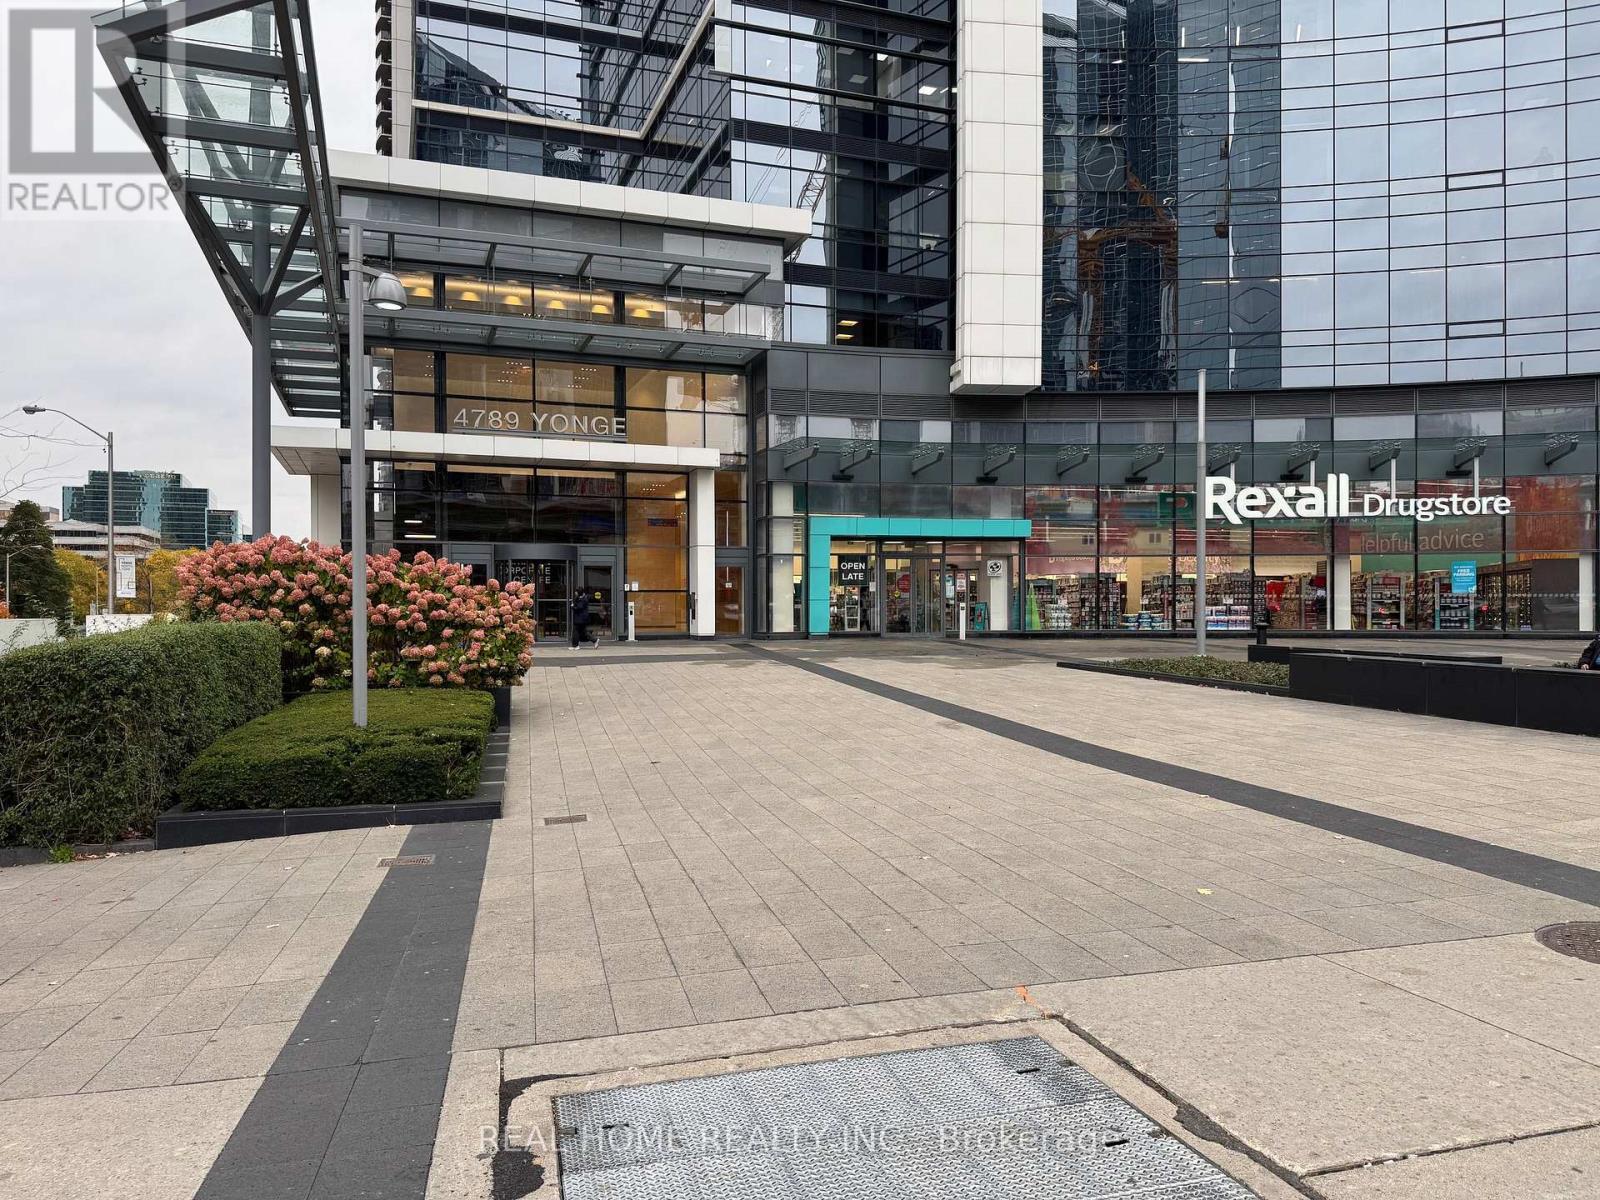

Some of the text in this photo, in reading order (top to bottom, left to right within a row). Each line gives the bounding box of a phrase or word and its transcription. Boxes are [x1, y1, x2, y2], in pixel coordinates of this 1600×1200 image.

[453, 408, 626, 436] 4789 YONGE
[1204, 473, 1511, 525] Rexall Drugstore
[1419, 528, 1485, 550] advice
[840, 562, 866, 570] OPEN
[841, 572, 865, 580] LATE
